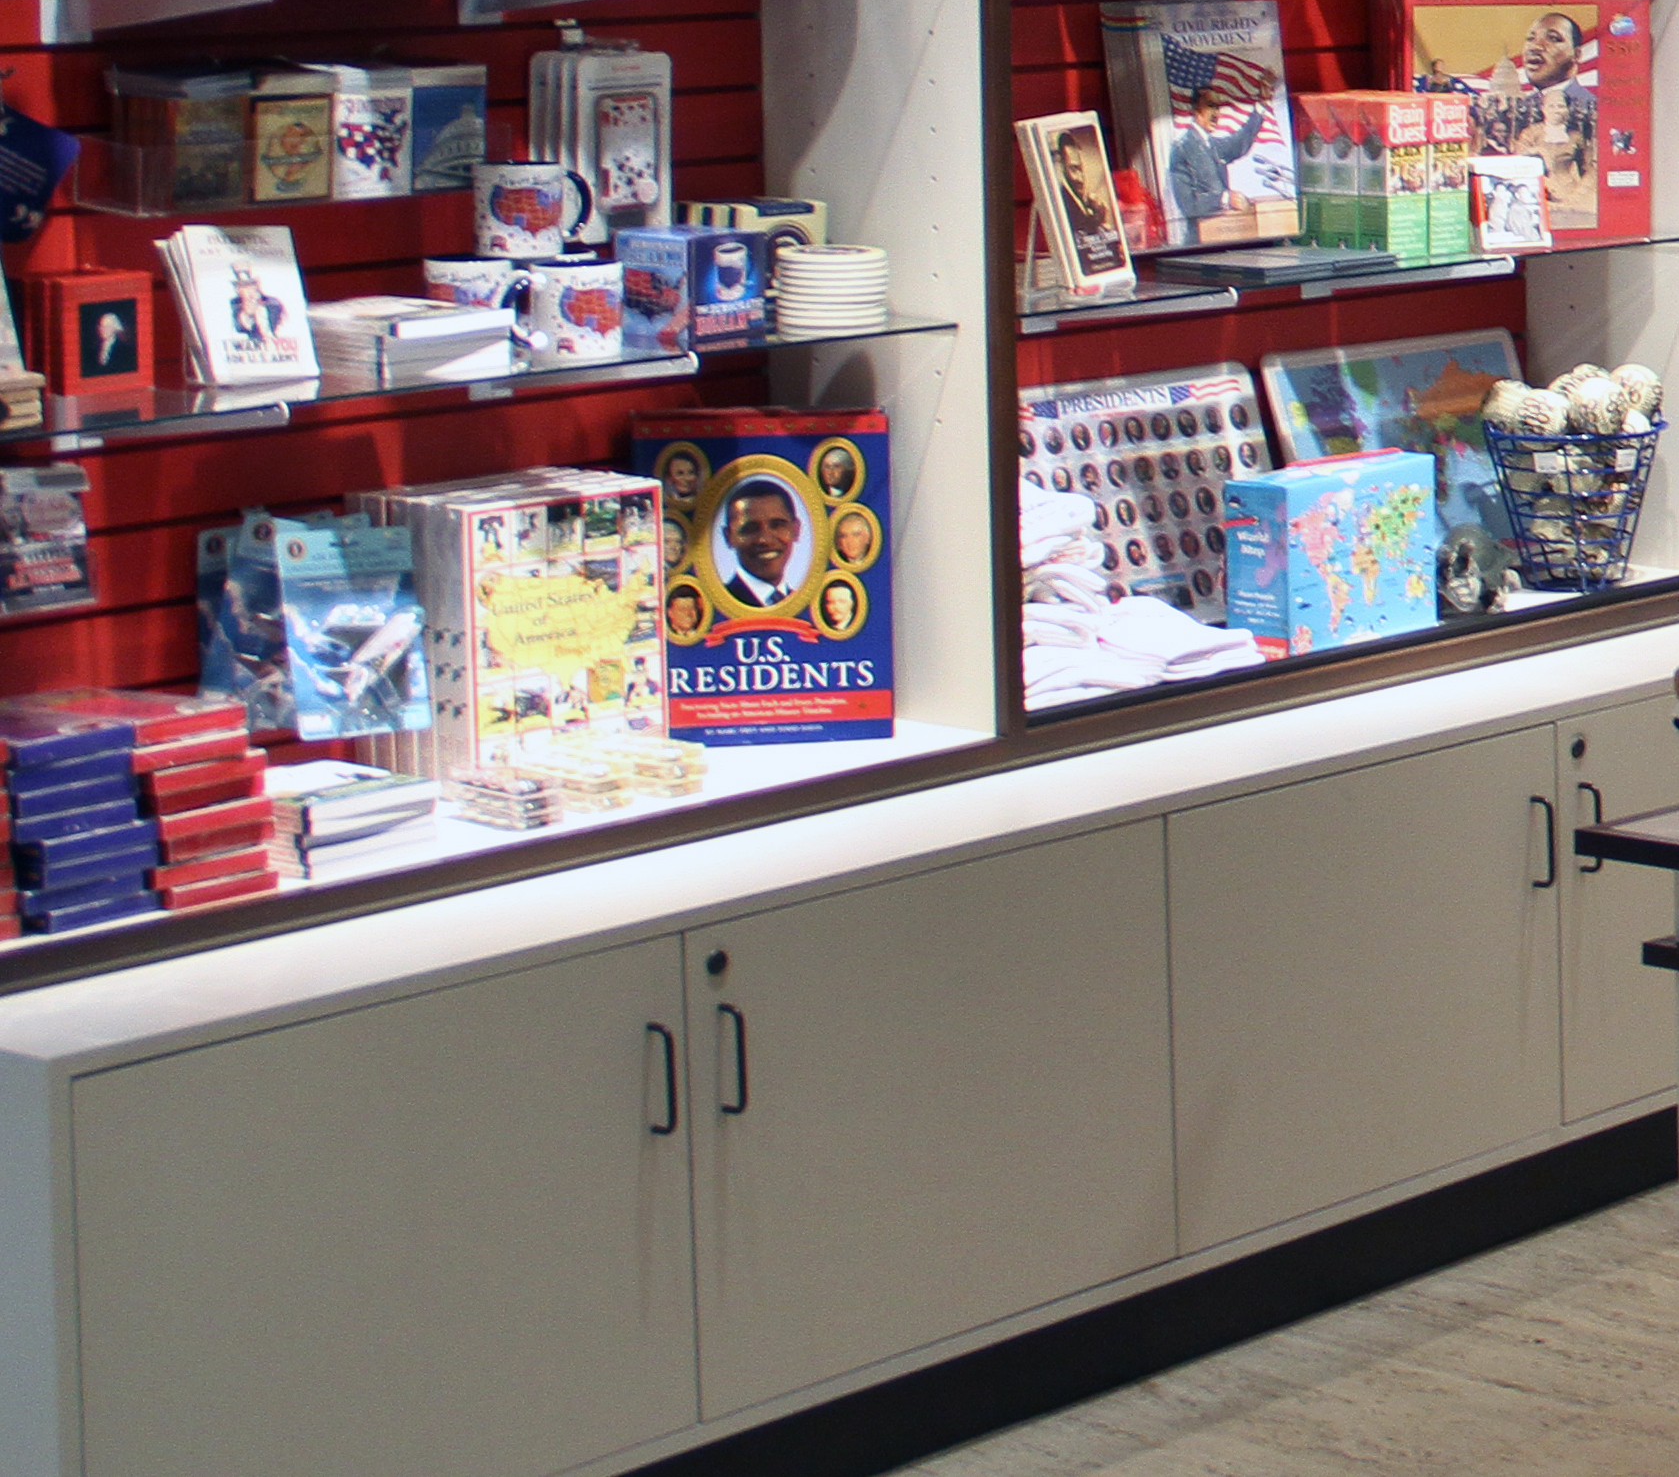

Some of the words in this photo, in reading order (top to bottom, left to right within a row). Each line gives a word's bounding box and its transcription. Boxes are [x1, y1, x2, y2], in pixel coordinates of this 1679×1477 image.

[1388, 103, 1426, 126] Brain
[1433, 100, 1468, 123] Brain
[1388, 124, 1428, 144] Quest
[1432, 121, 1471, 139] Quest
[1060, 386, 1169, 415] PRESIDENTS
[735, 636, 790, 663] U.S.
[669, 660, 875, 694] RESIDENTS
